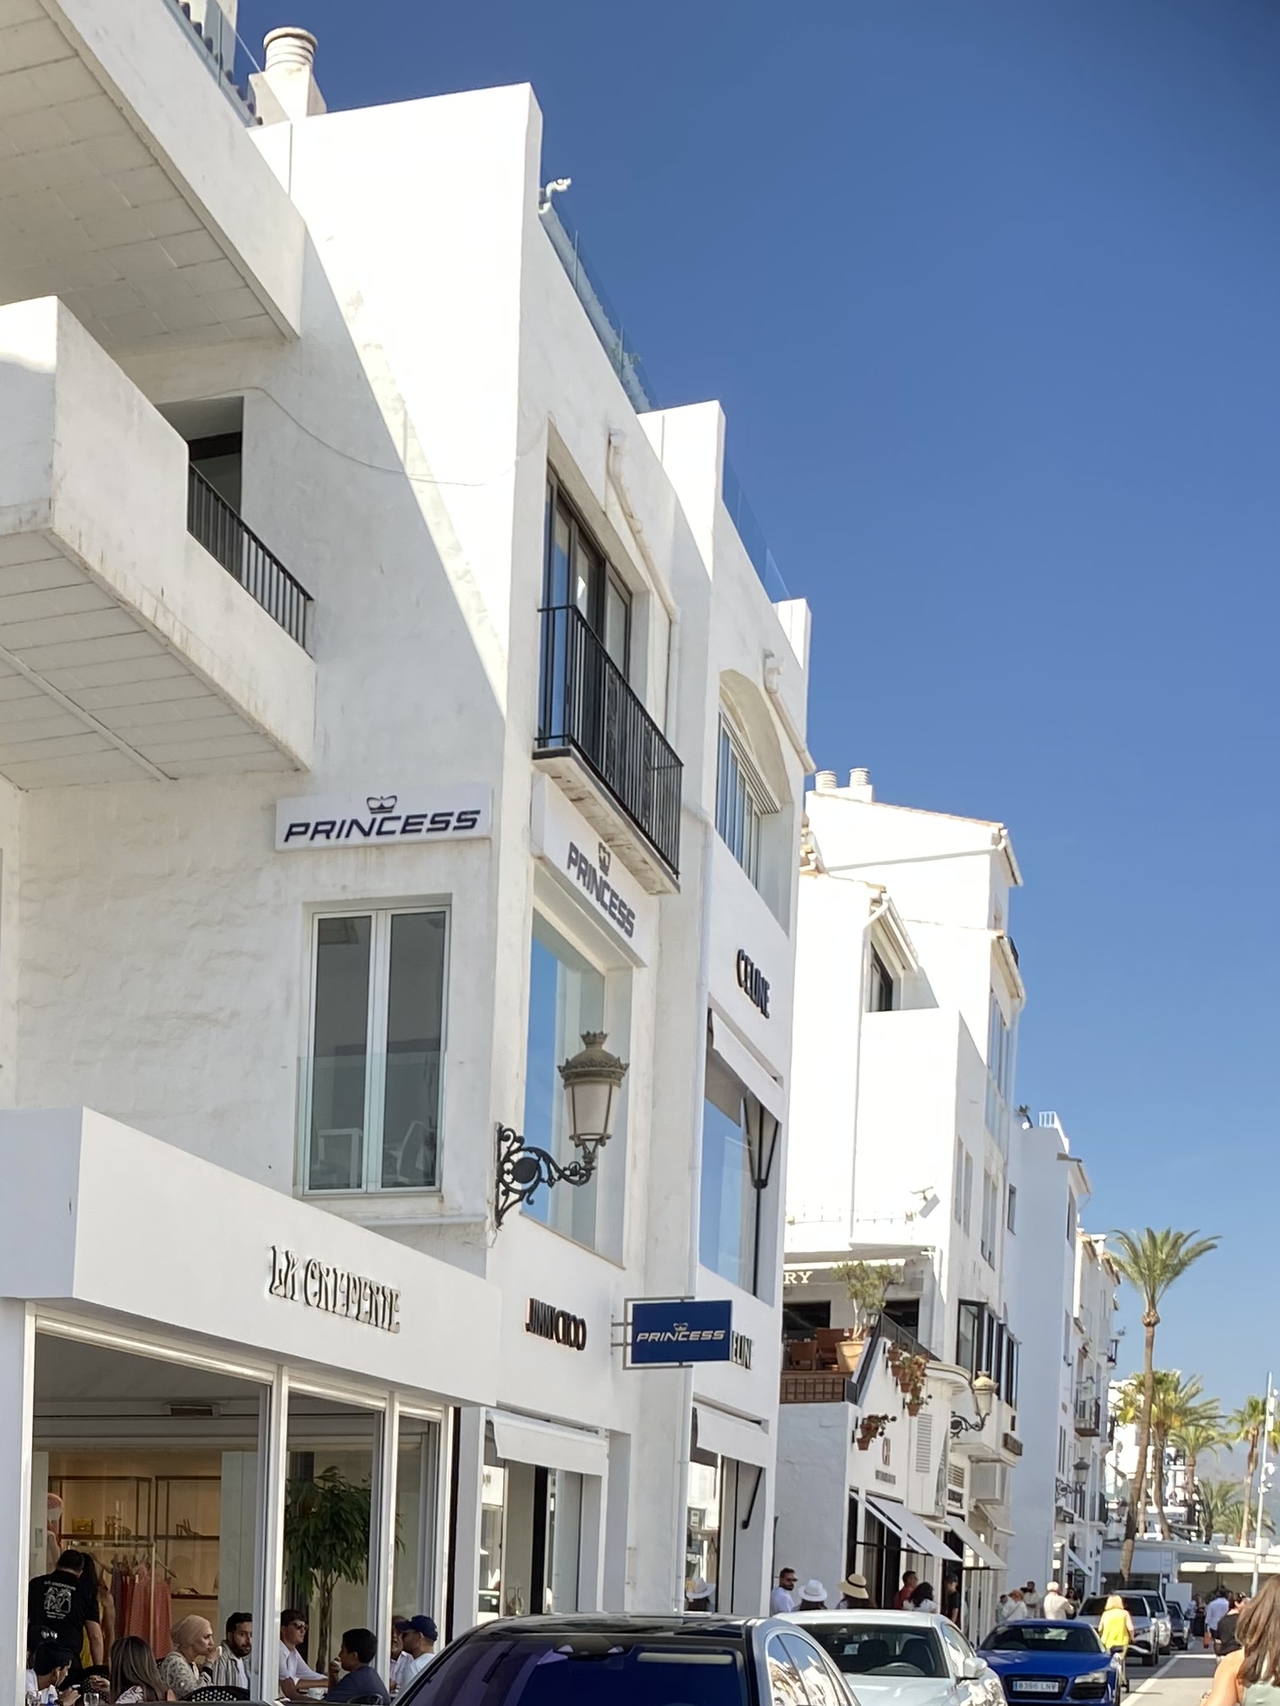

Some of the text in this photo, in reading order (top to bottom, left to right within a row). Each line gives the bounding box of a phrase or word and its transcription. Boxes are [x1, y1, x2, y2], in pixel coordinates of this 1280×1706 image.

[283, 809, 482, 843] PRINCESS
[566, 841, 637, 939] PRINCESS
[736, 949, 770, 1020] CELINE
[269, 1244, 299, 1302] LA
[525, 1297, 587, 1352] JIMMY CHOO
[636, 1329, 726, 1343] PRINCESS
